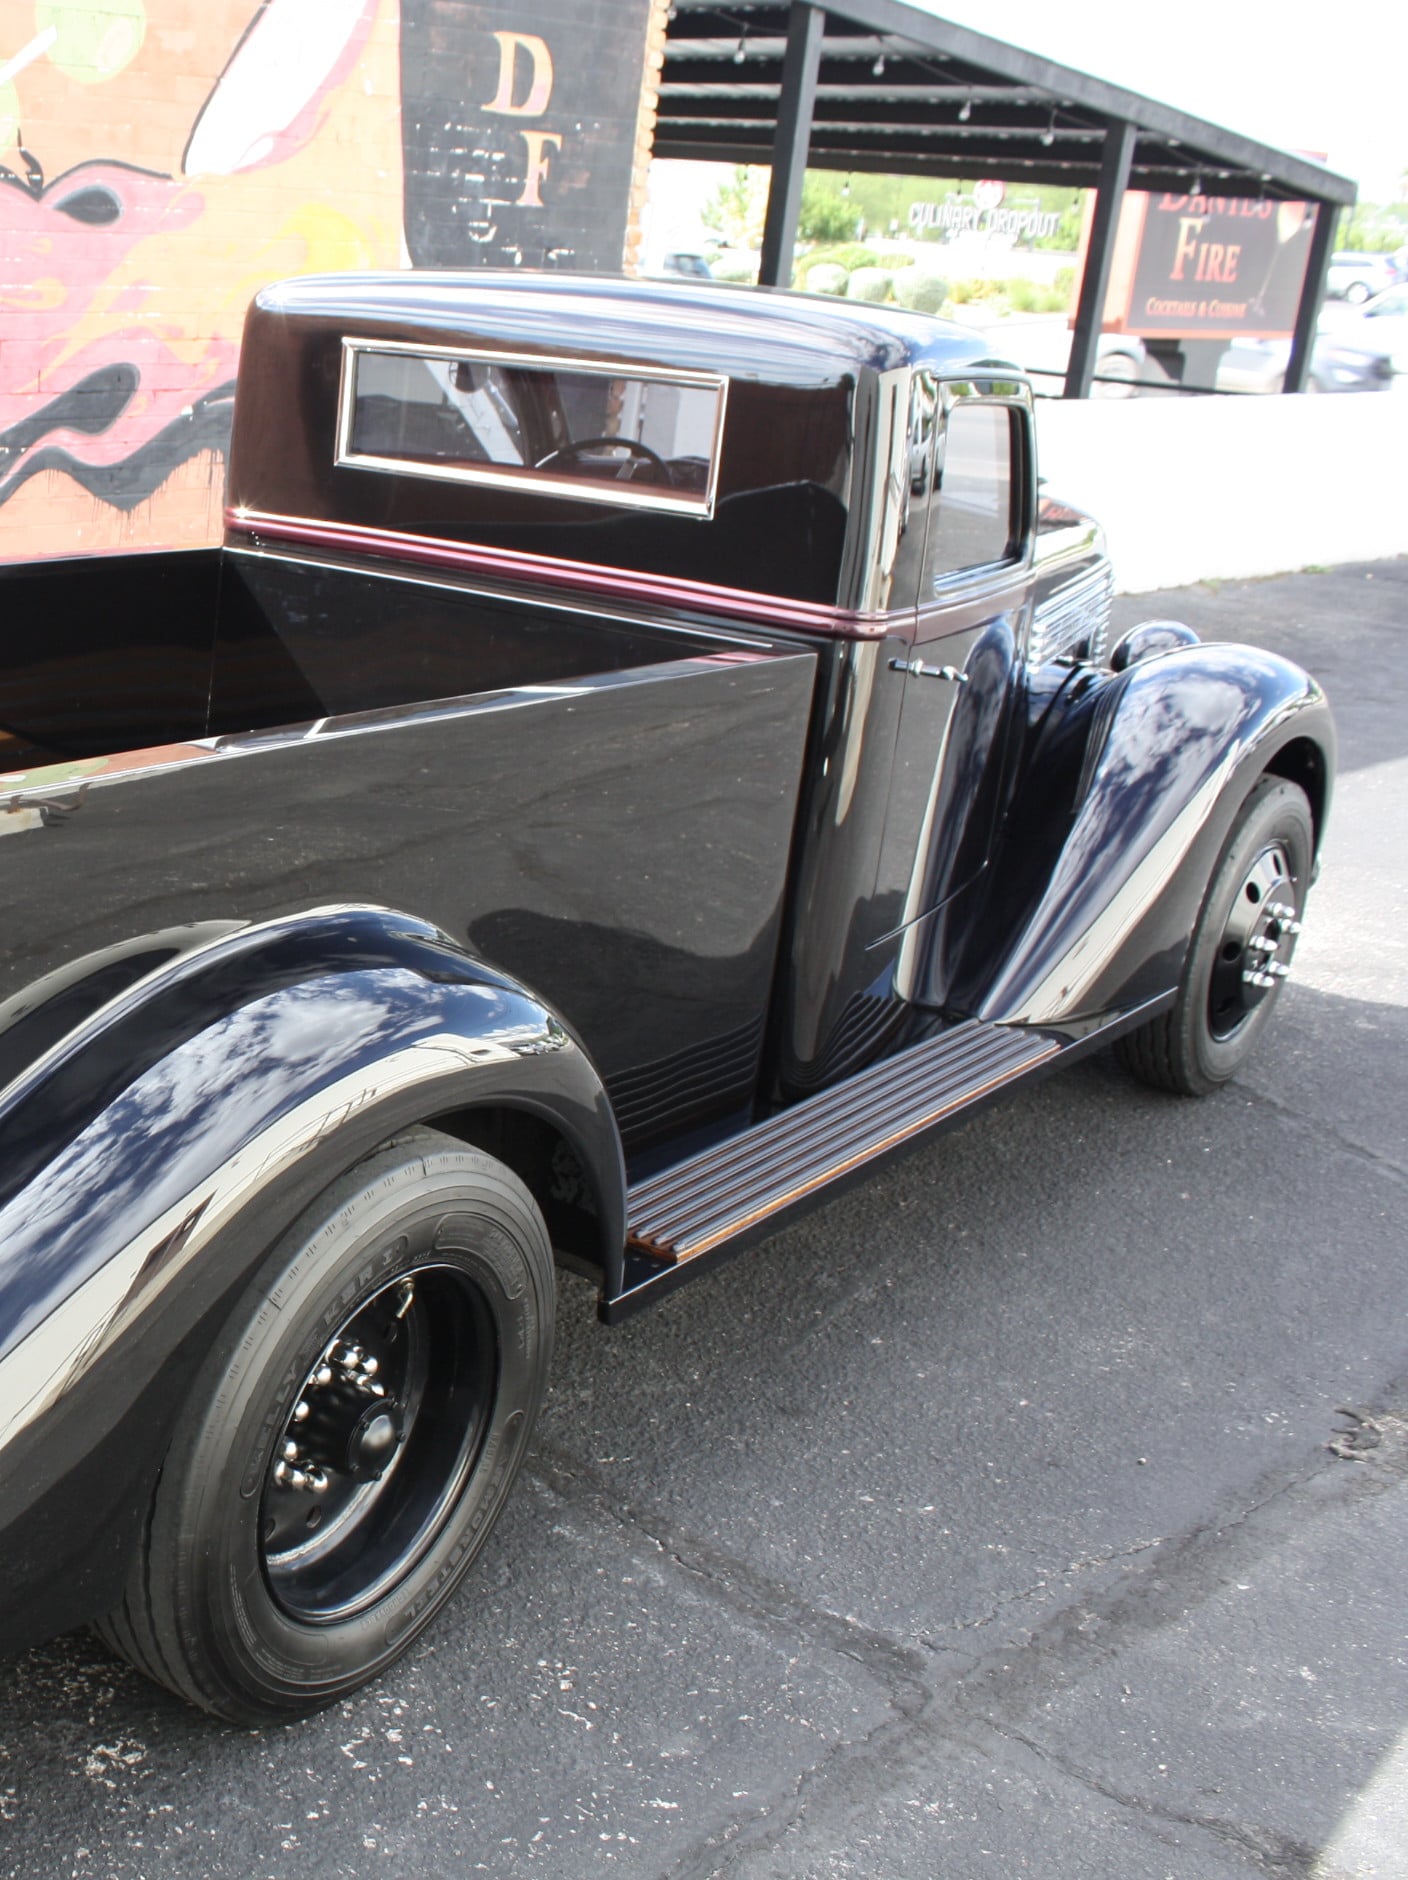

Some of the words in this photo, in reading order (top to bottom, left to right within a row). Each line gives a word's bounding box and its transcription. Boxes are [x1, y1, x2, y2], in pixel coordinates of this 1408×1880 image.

[481, 31, 553, 117] D
[516, 130, 562, 207] F
[910, 202, 983, 231] CULINARY
[988, 207, 1060, 238] DROPOUT
[1158, 192, 1272, 219] DANTES
[1169, 216, 1241, 282] FIRE
